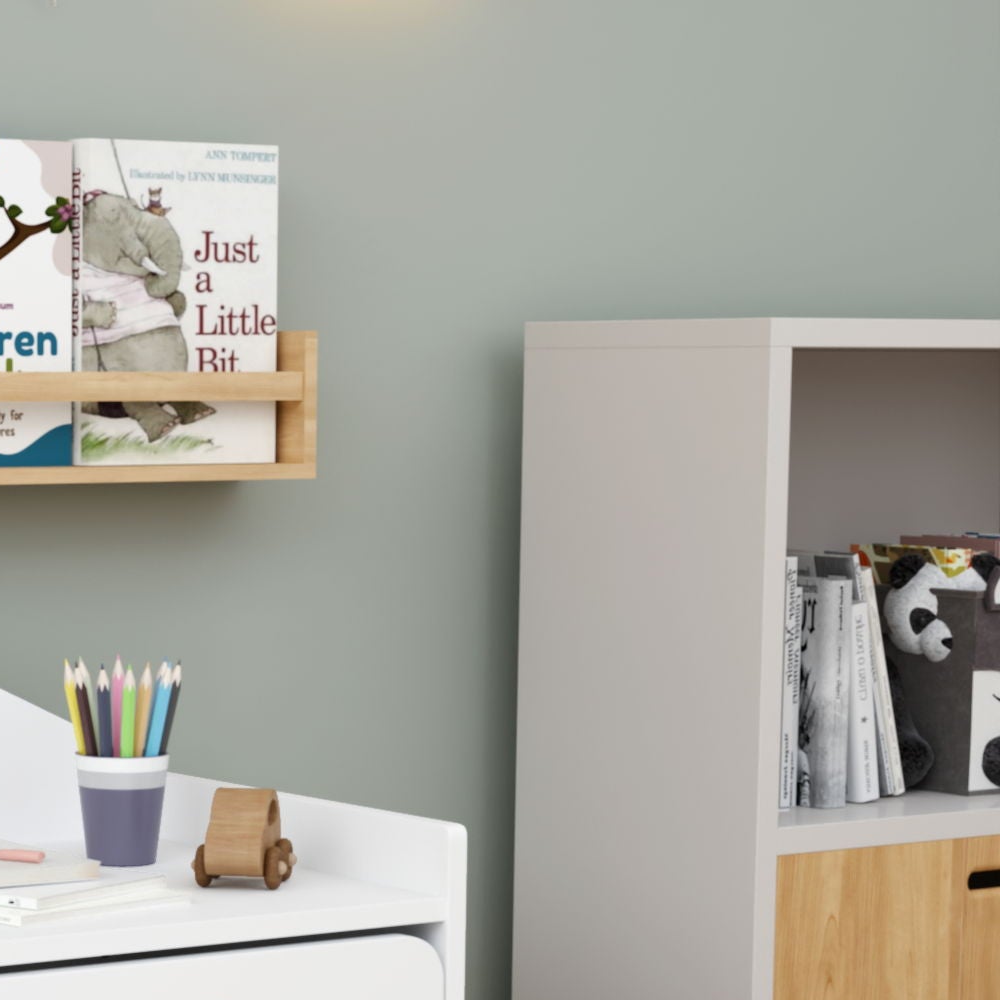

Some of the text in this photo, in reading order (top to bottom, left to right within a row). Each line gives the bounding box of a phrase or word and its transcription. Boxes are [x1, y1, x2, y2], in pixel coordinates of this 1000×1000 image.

[205, 150, 277, 162] ANN TOMPERT
[129, 168, 277, 185] Illustrated by LYNN MUNSINGER
[193, 230, 260, 263] Just
[195, 271, 213, 293] a
[195, 304, 276, 336] Little
[10, 409, 24, 421] for
